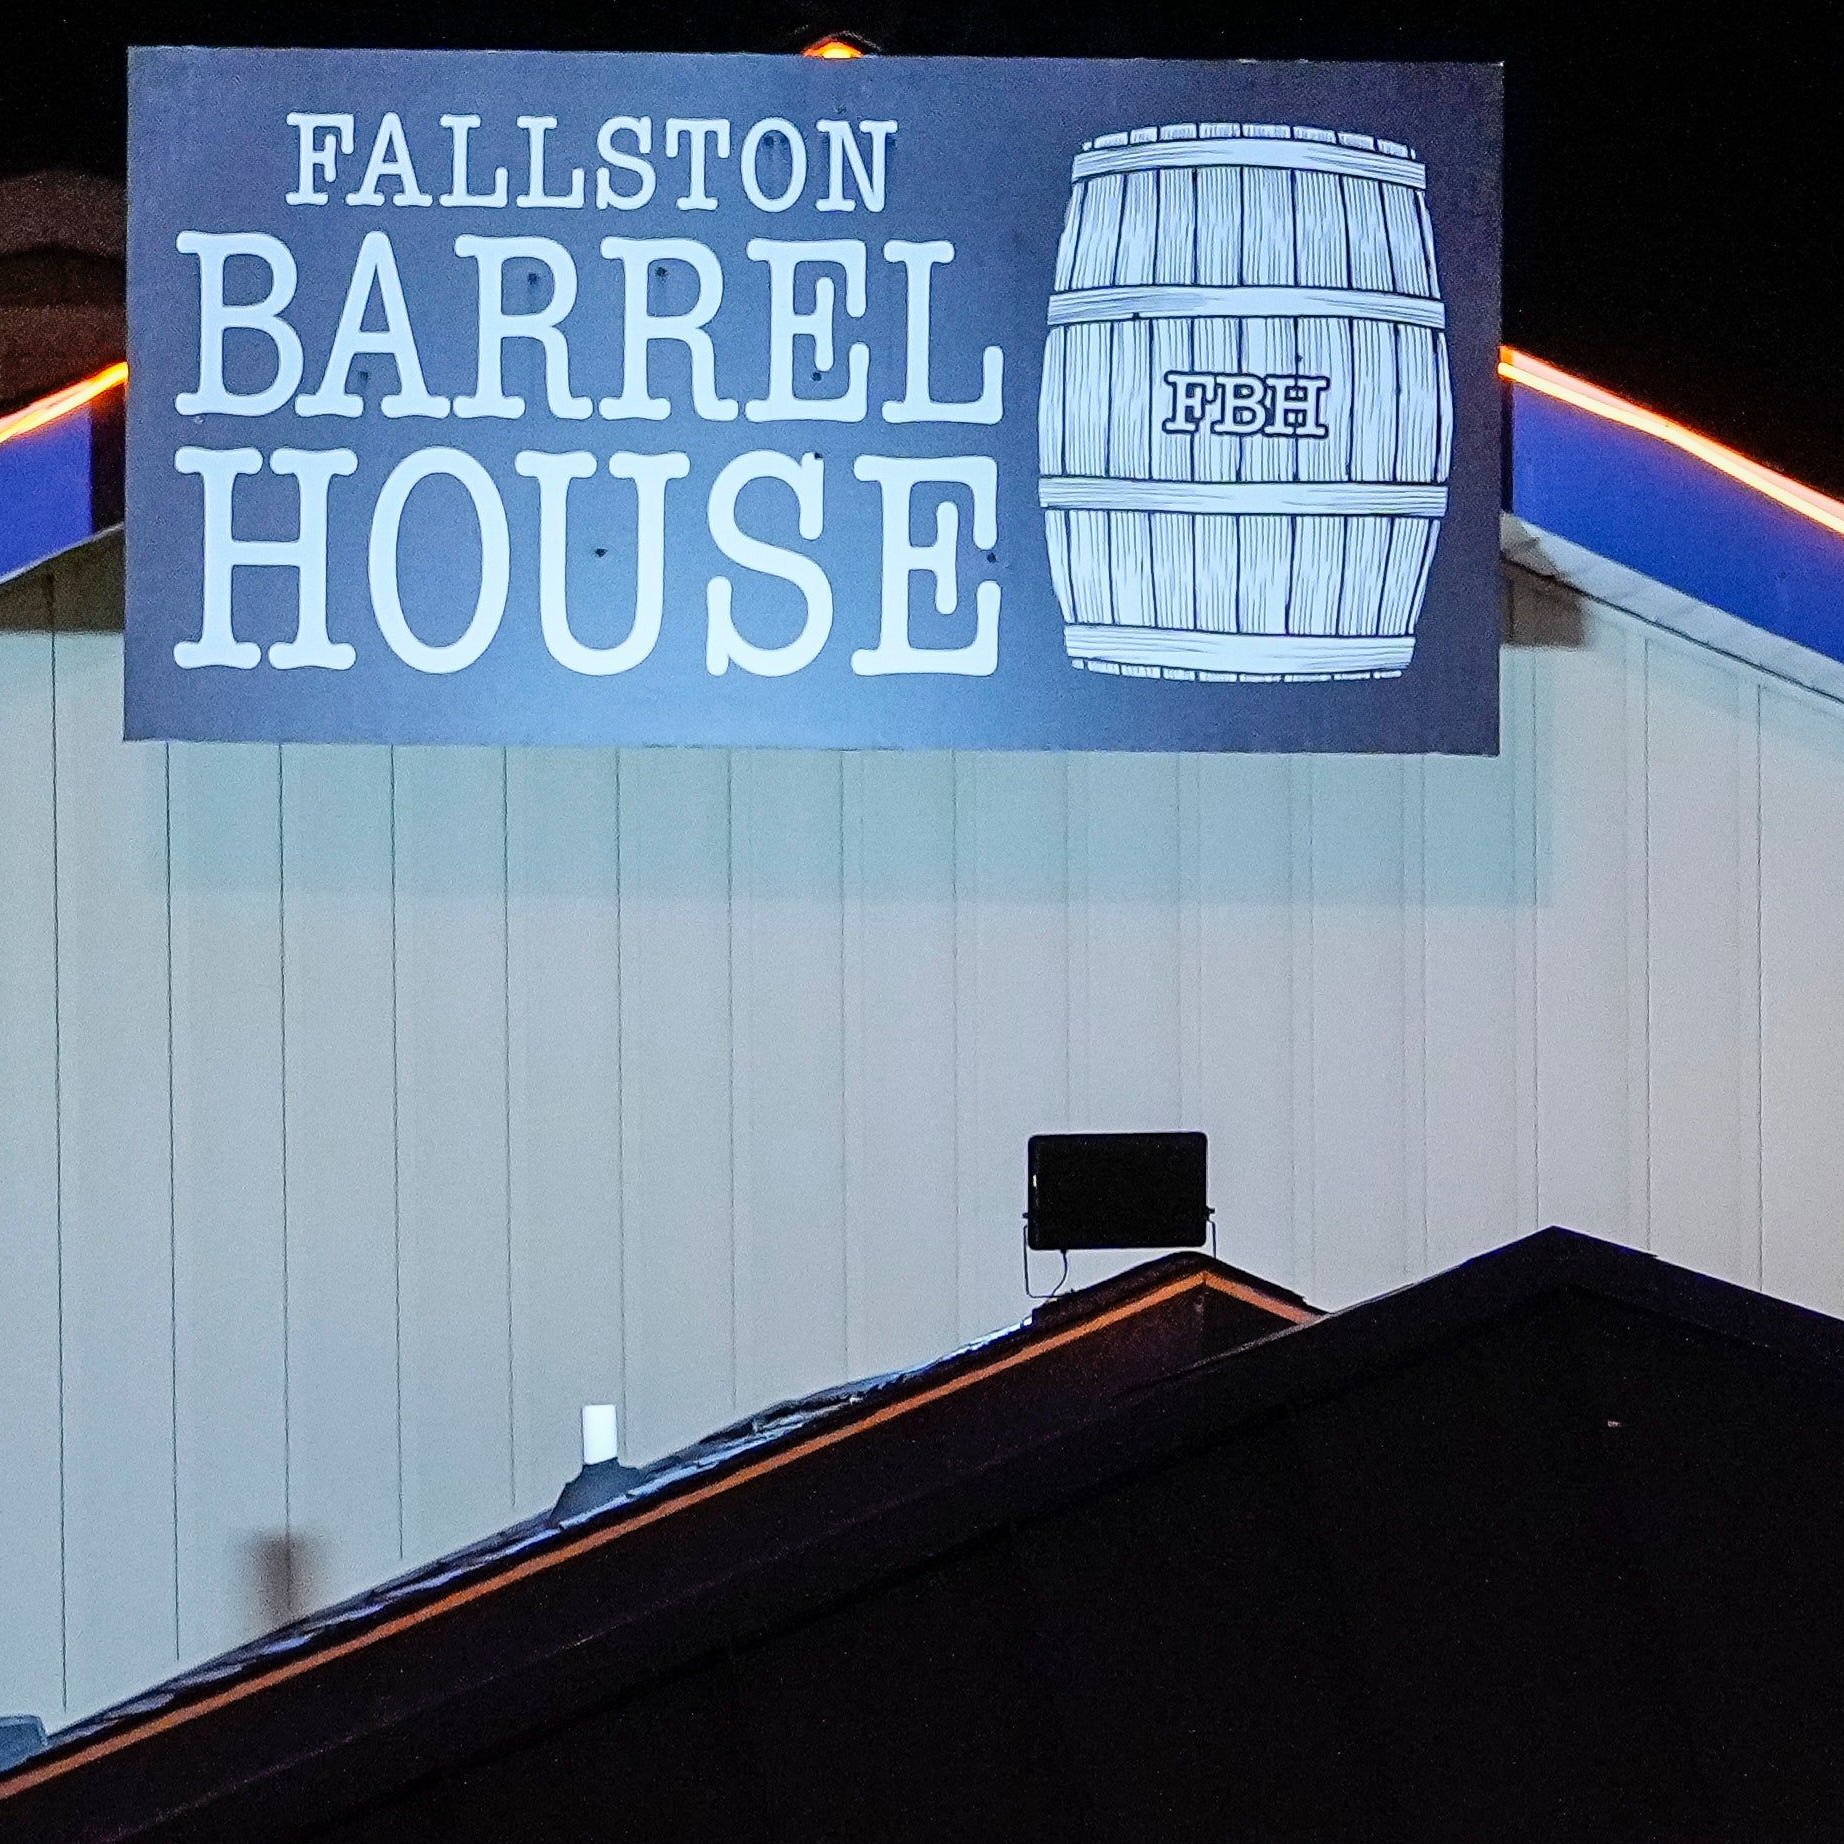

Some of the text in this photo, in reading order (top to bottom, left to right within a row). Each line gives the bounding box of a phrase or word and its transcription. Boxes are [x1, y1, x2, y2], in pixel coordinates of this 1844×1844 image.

[286, 111, 899, 213] FALLSTON
[174, 229, 1005, 426] BARREL
[1161, 371, 1331, 440] FBH
[172, 444, 1003, 679] HOUSE
